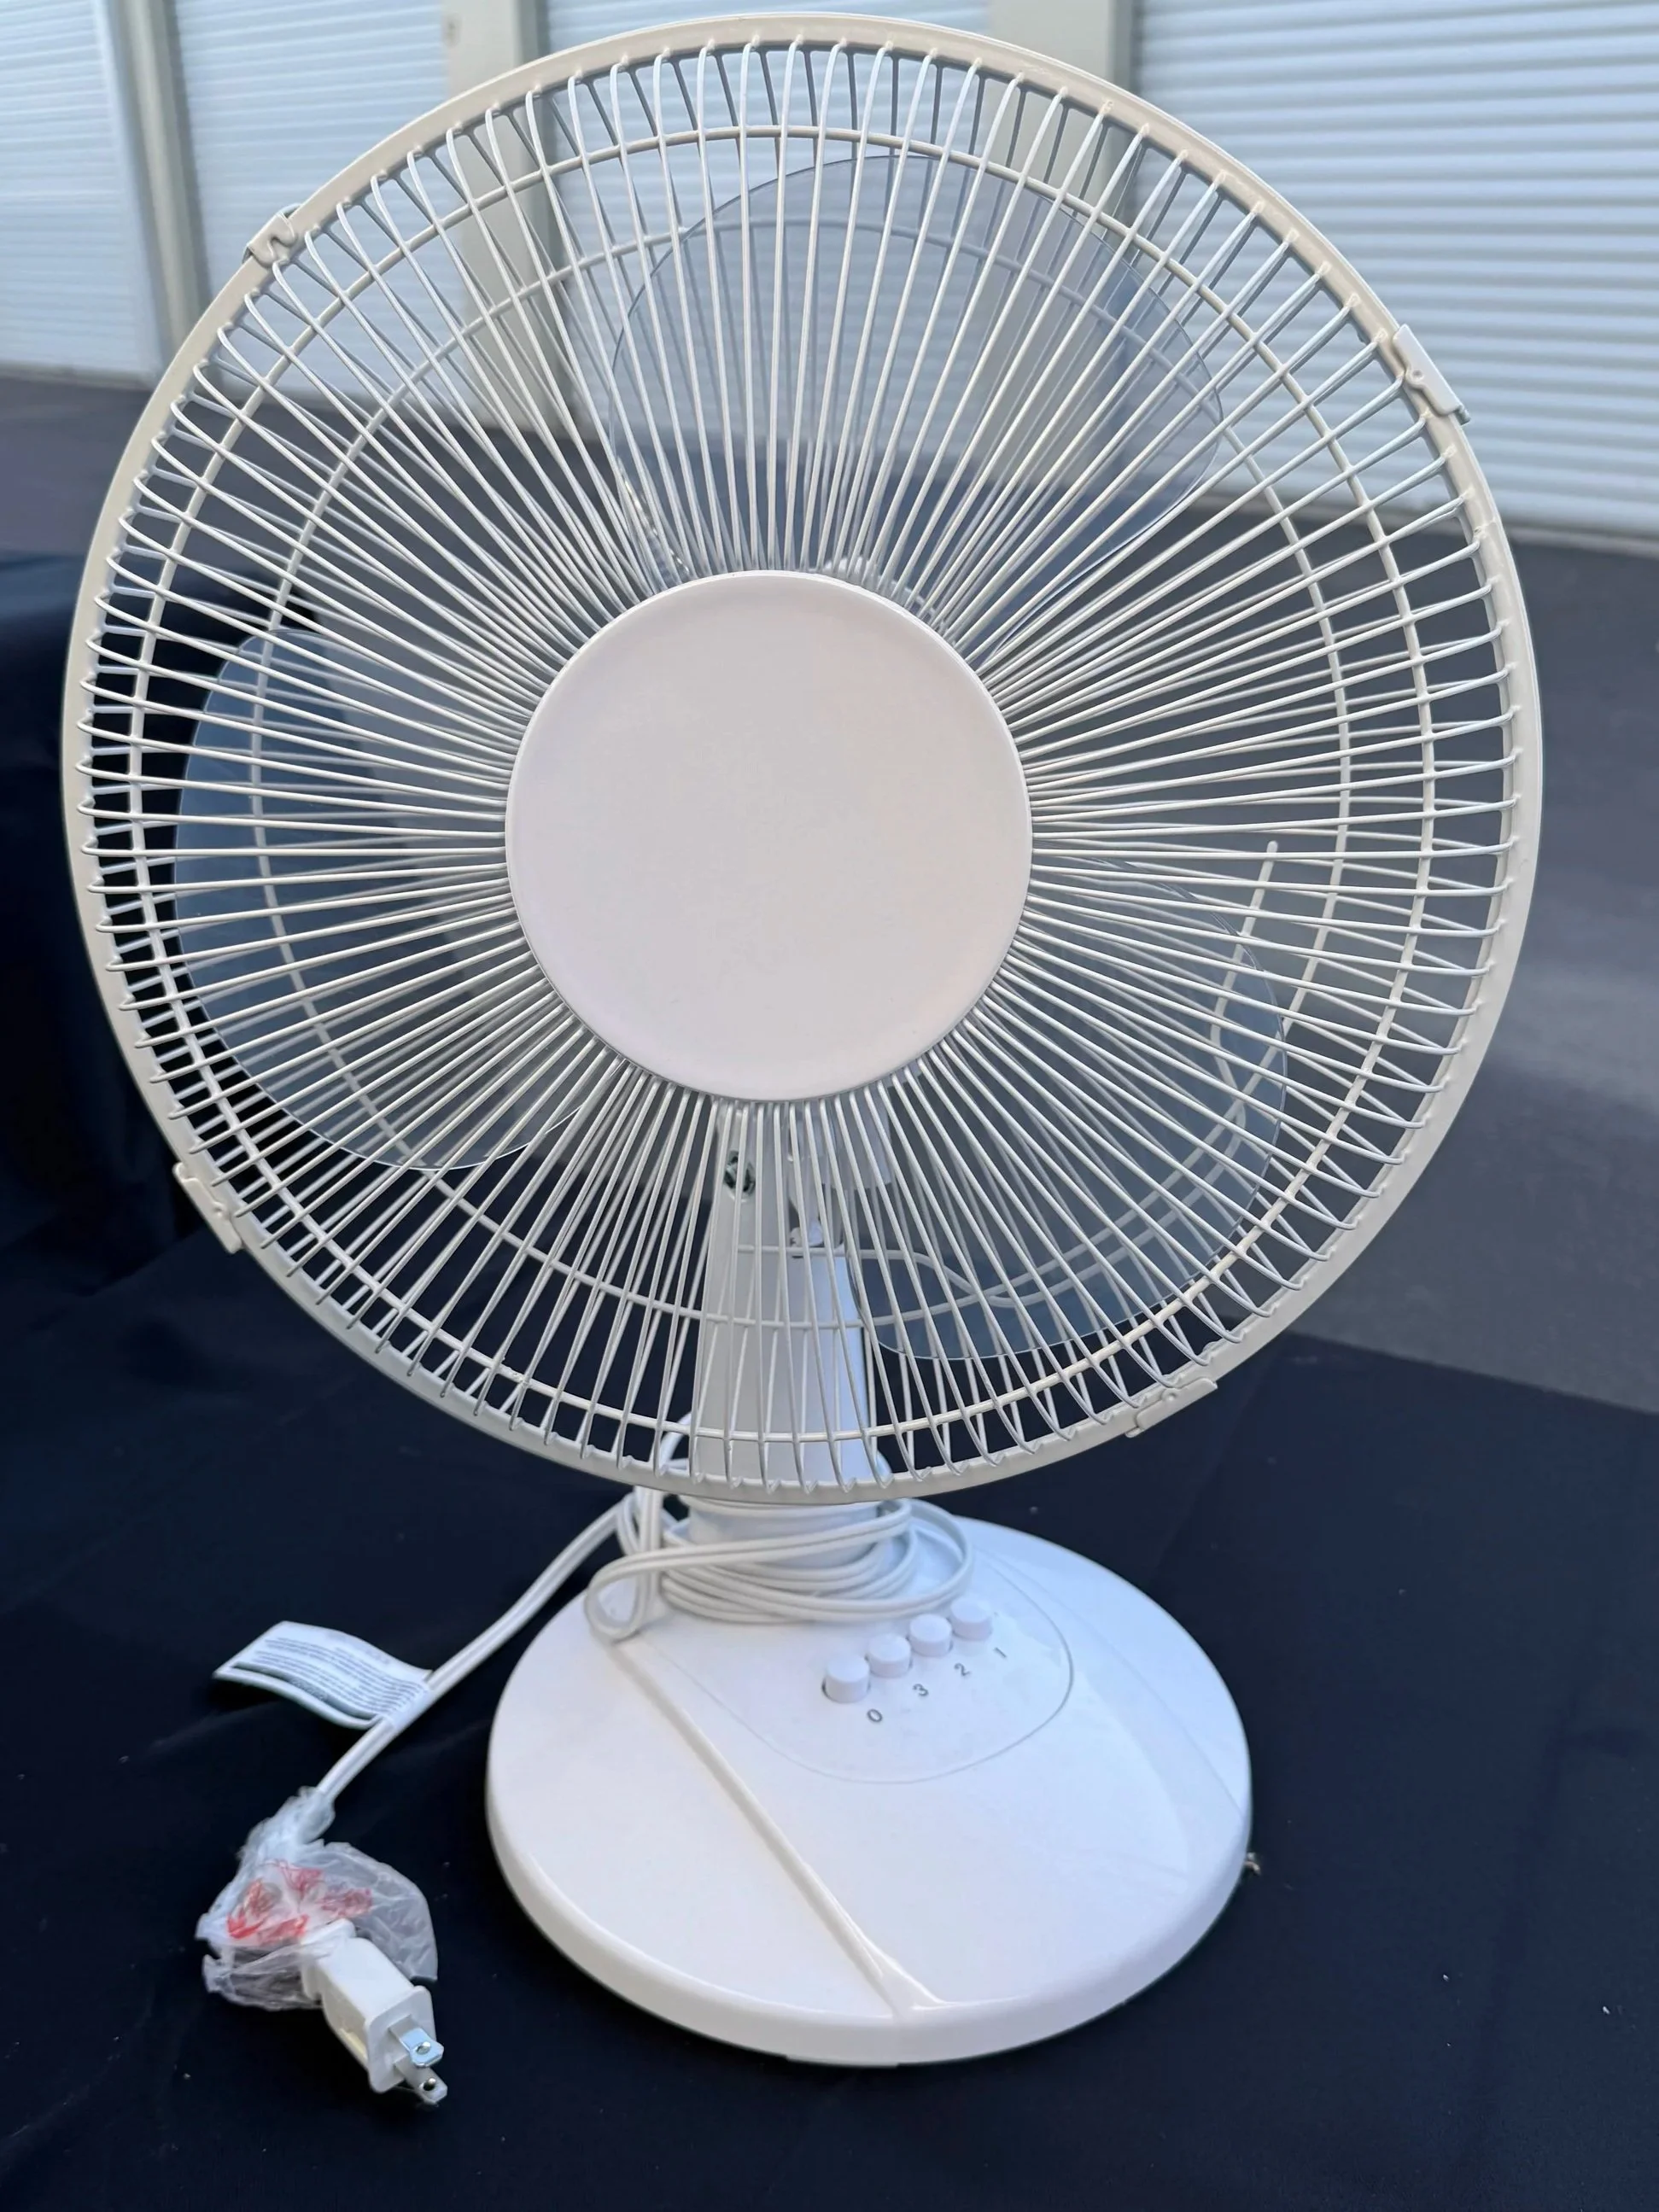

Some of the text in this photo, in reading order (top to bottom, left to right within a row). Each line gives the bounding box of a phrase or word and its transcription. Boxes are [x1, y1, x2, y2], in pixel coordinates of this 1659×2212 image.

[913, 1684, 929, 1697] 3
[955, 1663, 970, 1677] 2
[994, 1647, 1008, 1659] 1
